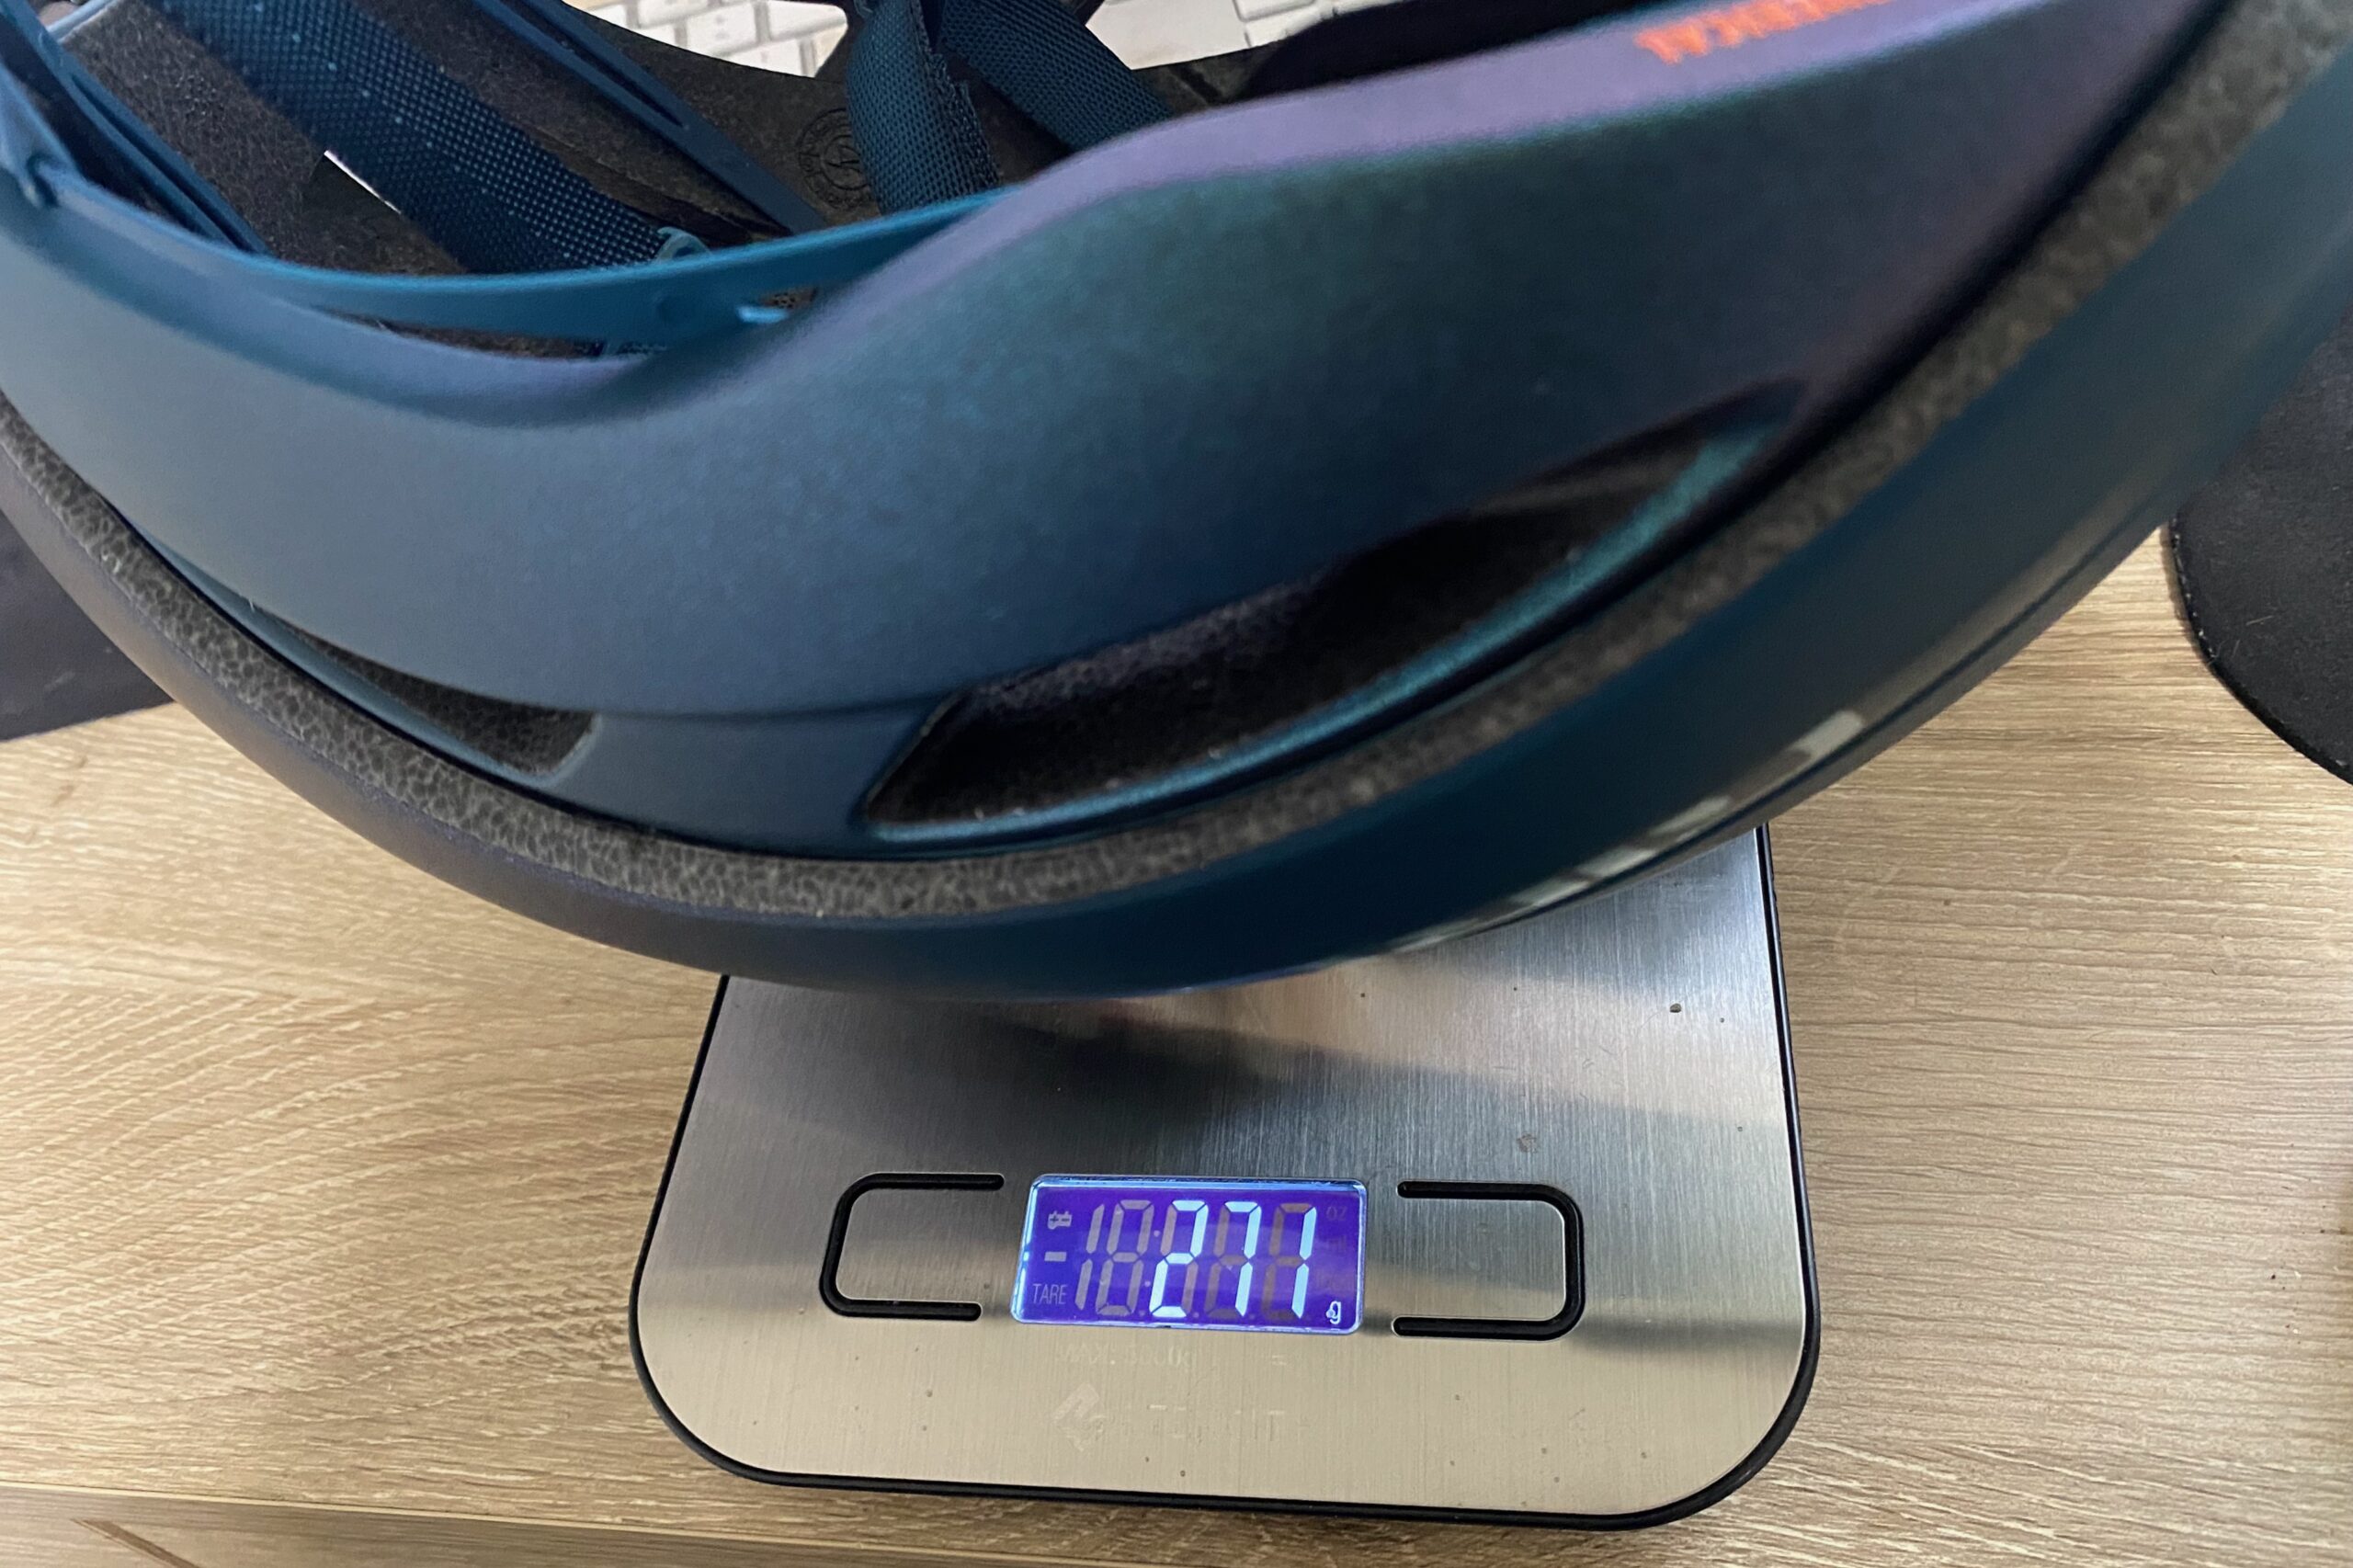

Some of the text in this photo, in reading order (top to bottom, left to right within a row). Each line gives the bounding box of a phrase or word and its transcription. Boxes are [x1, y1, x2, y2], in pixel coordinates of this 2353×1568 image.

[1149, 1199, 1316, 1319] 271
[1032, 1283, 1069, 1306] TARE
[1326, 1301, 1341, 1324] g
